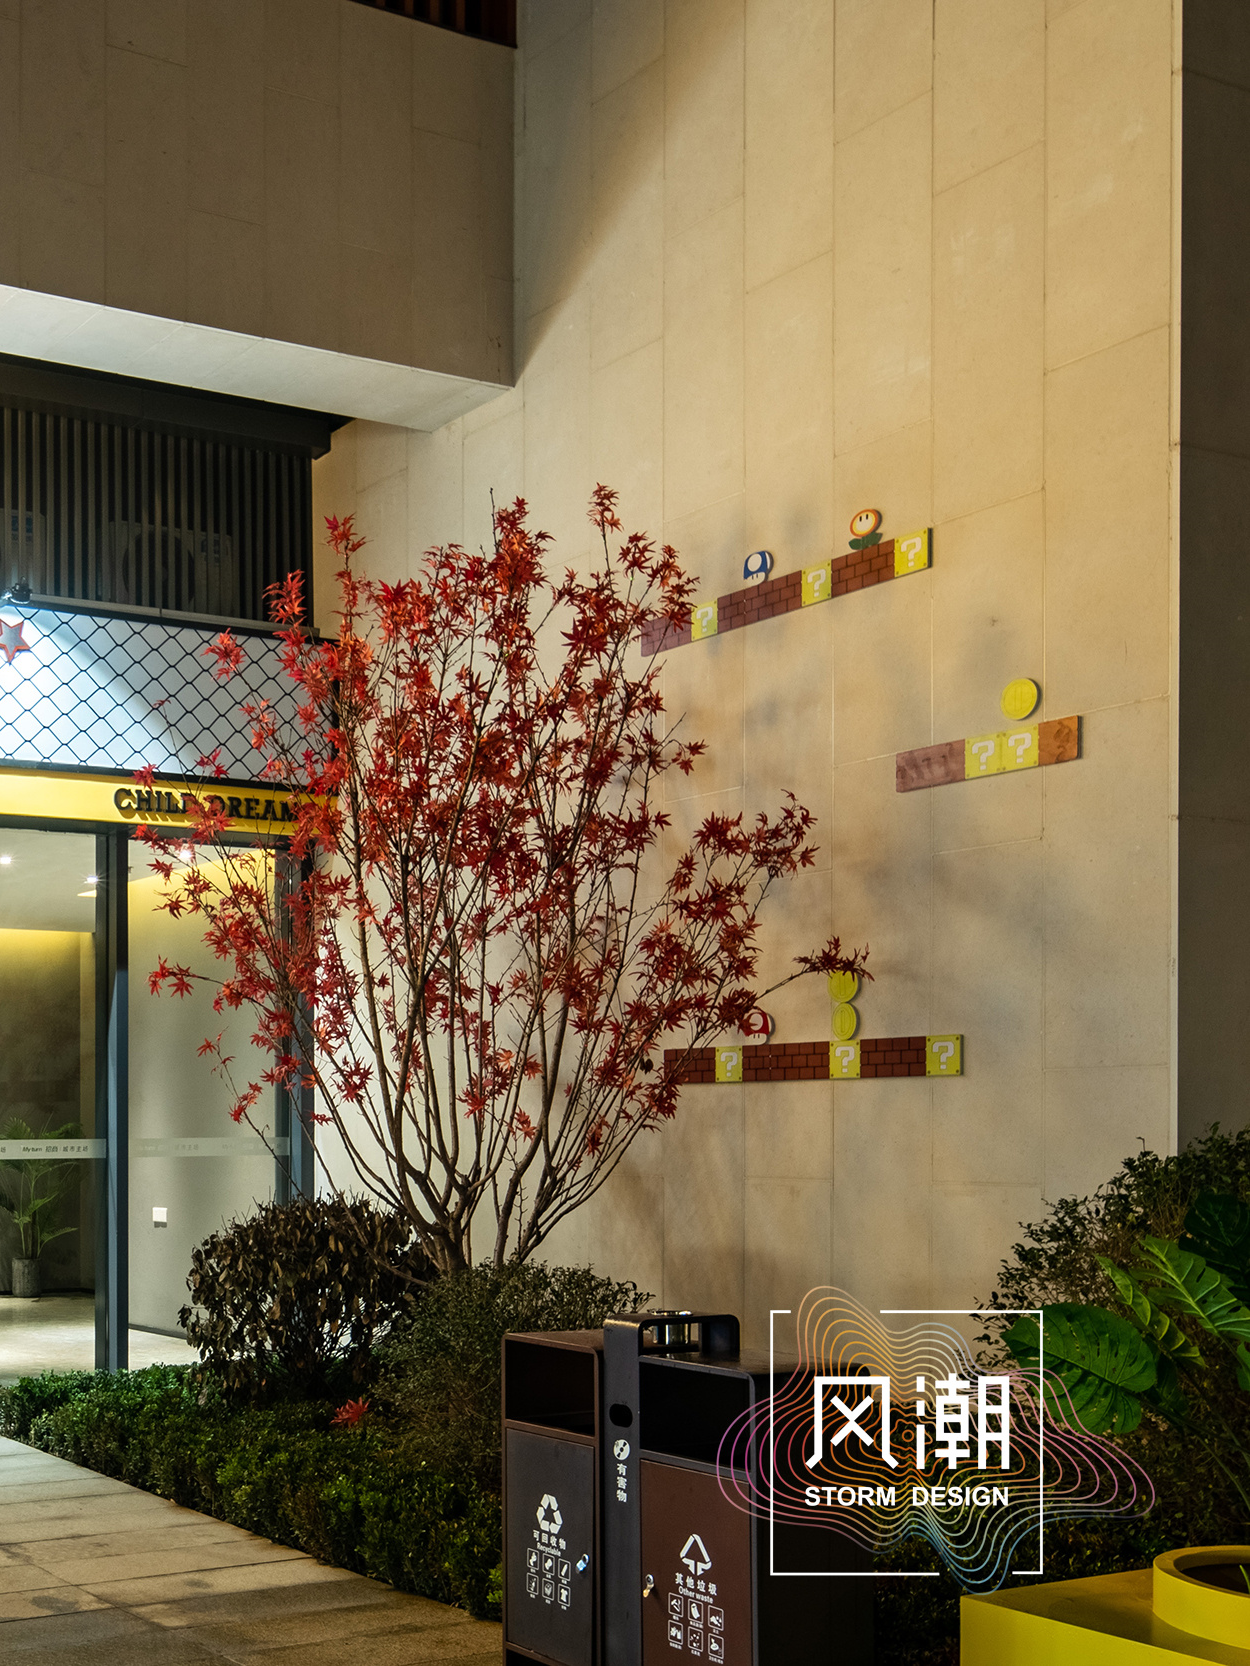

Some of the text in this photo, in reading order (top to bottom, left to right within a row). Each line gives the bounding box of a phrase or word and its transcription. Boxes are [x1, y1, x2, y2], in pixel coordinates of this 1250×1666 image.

[616, 1463, 627, 1503] 有害物
[533, 1529, 566, 1550] 可回收物
[675, 1572, 717, 1596] 其他垃圾
[678, 1586, 714, 1604] Other waste
